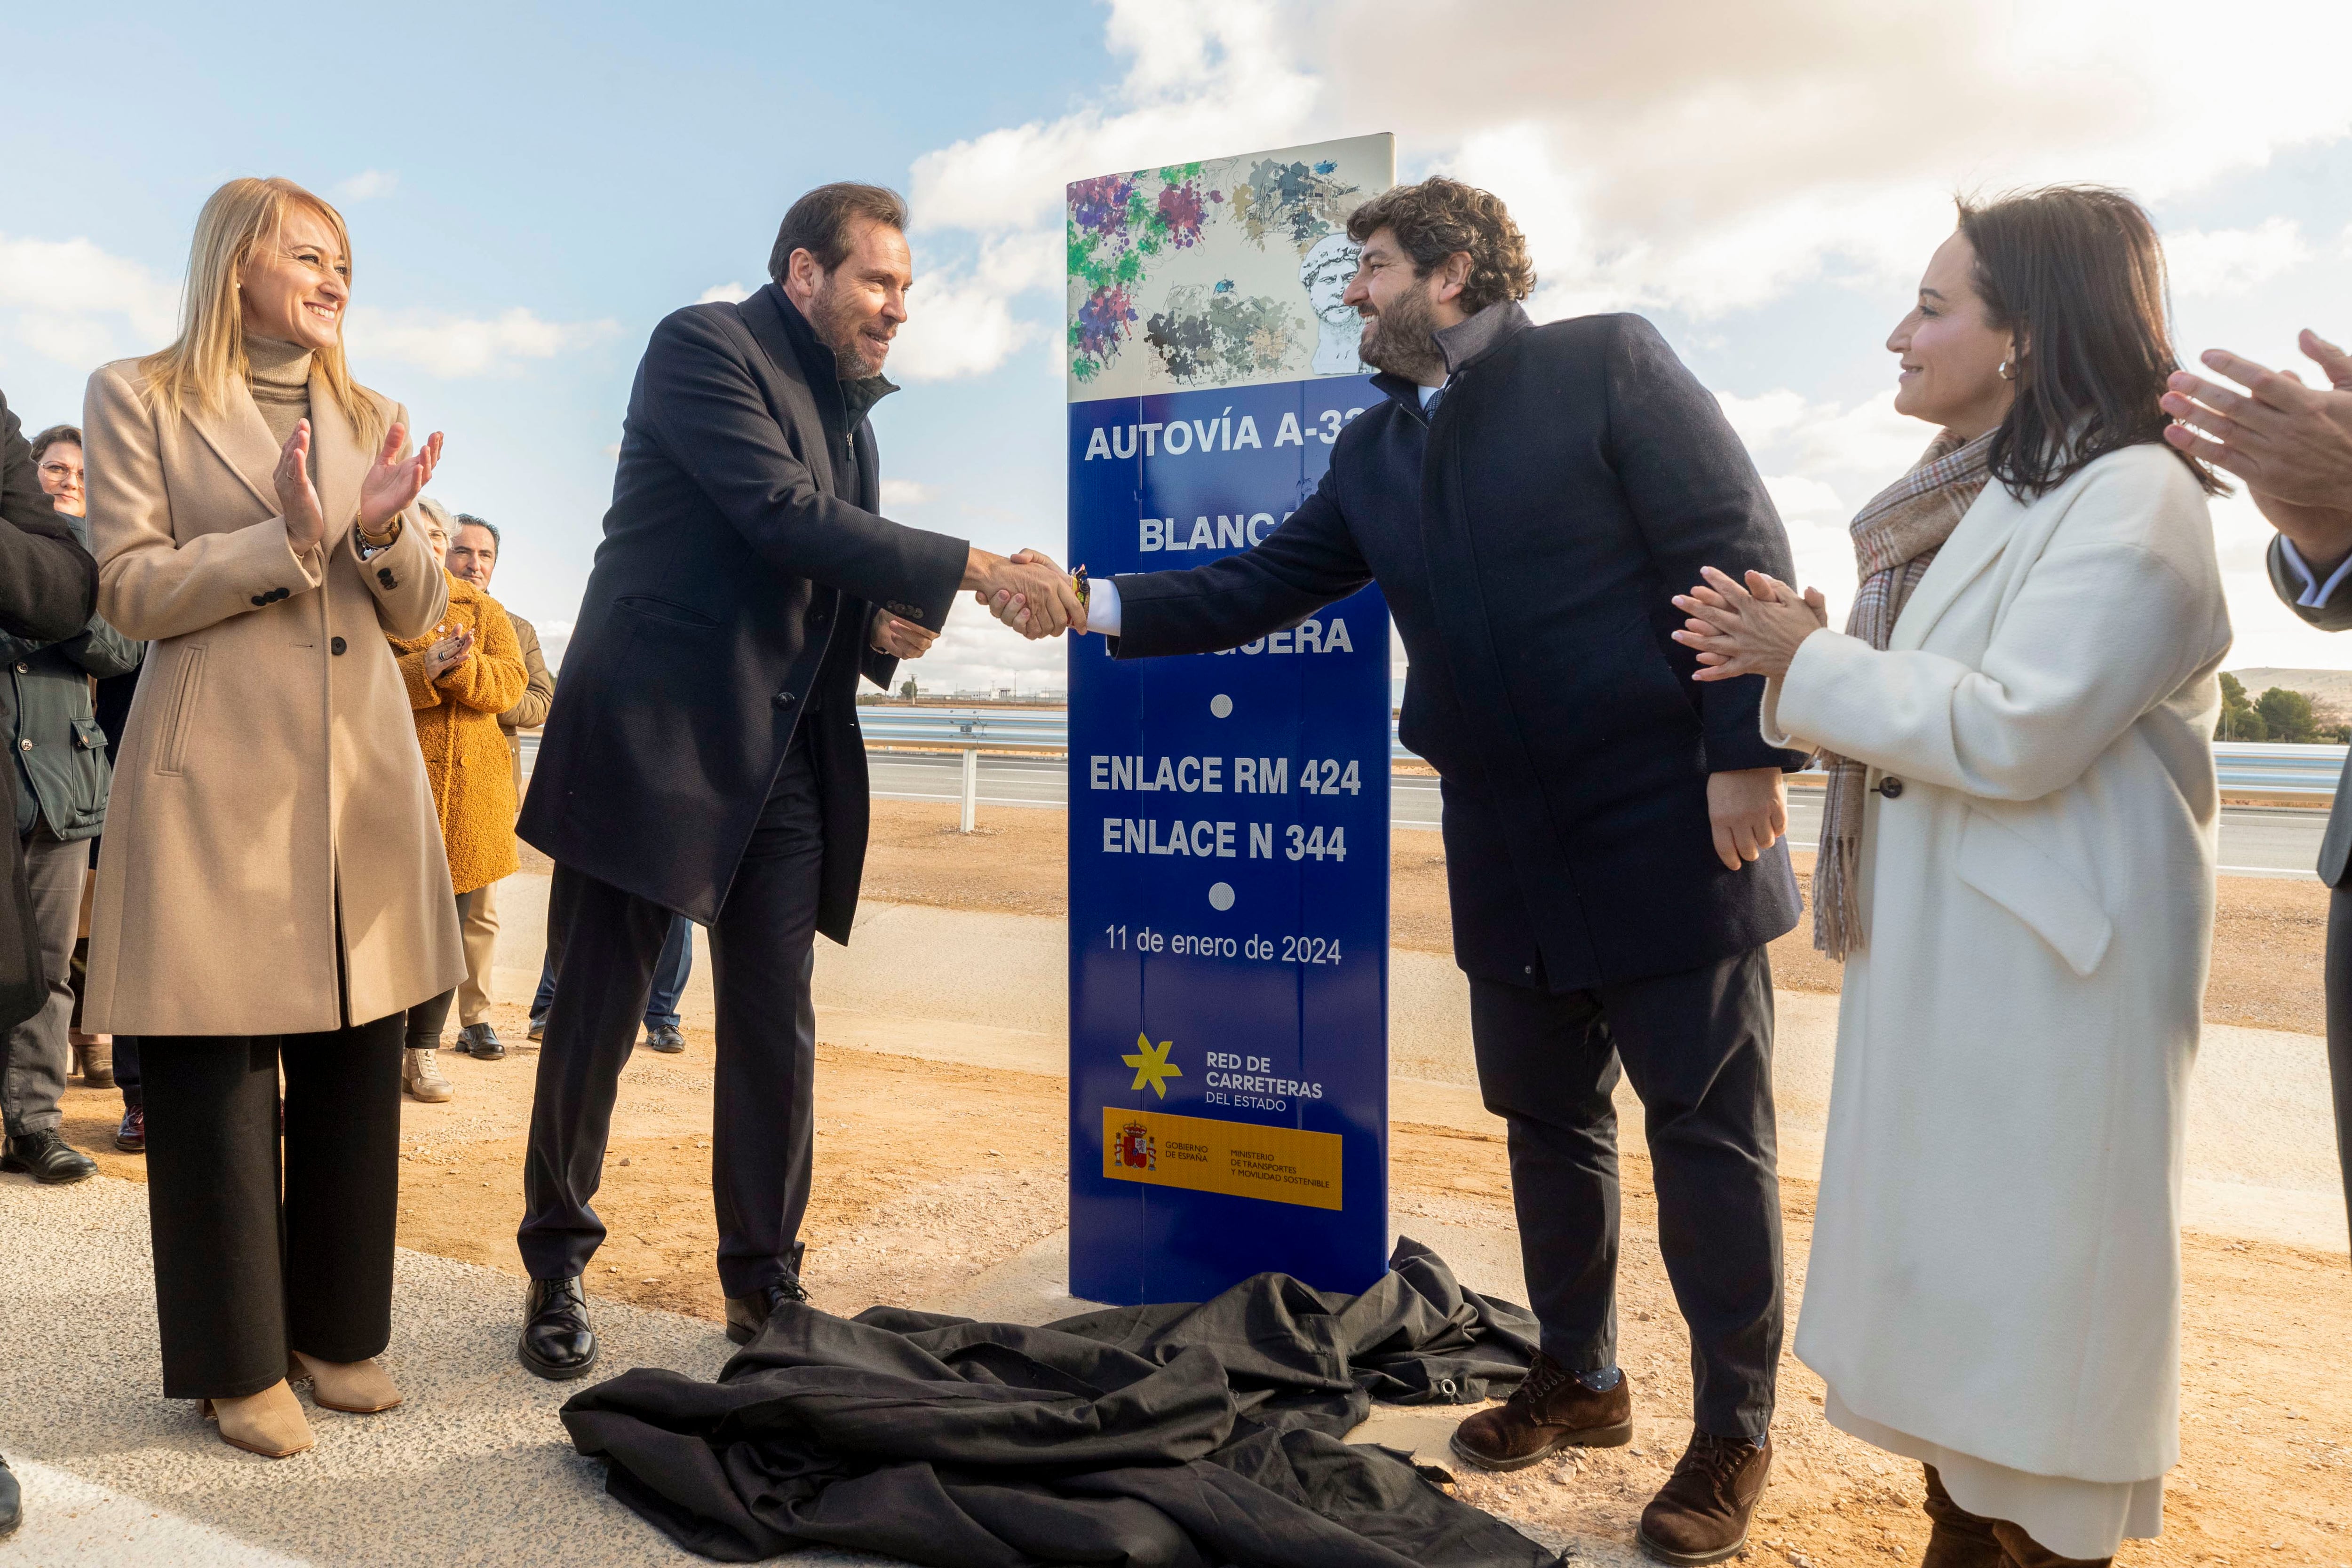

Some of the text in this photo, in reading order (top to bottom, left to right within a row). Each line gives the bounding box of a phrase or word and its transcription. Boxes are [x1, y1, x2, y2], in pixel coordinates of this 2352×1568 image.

[1085, 406, 1366, 460] AUTOVÍA A-3
[1139, 512, 1295, 552] BLANC
[1091, 755, 1361, 795] ENLACE RM 424
[1104, 818, 1346, 862] ENLACE N 344
[1106, 924, 1342, 965] 11 de enero de 2024
[1207, 1052, 1270, 1073] RED DE
[1206, 1071, 1322, 1099] CARRETERAS
[1206, 1092, 1286, 1112] DEL ESTADO
[1165, 1141, 1208, 1153] GOBIERNO
[1178, 1152, 1208, 1163] ESPAÑA
[1231, 1149, 1274, 1161] MINISTERIO
[1242, 1160, 1297, 1174] TRANSPORTES
[1238, 1169, 1281, 1181] MOVILIDAD
[1284, 1176, 1330, 1188] SOSTENIBLE
